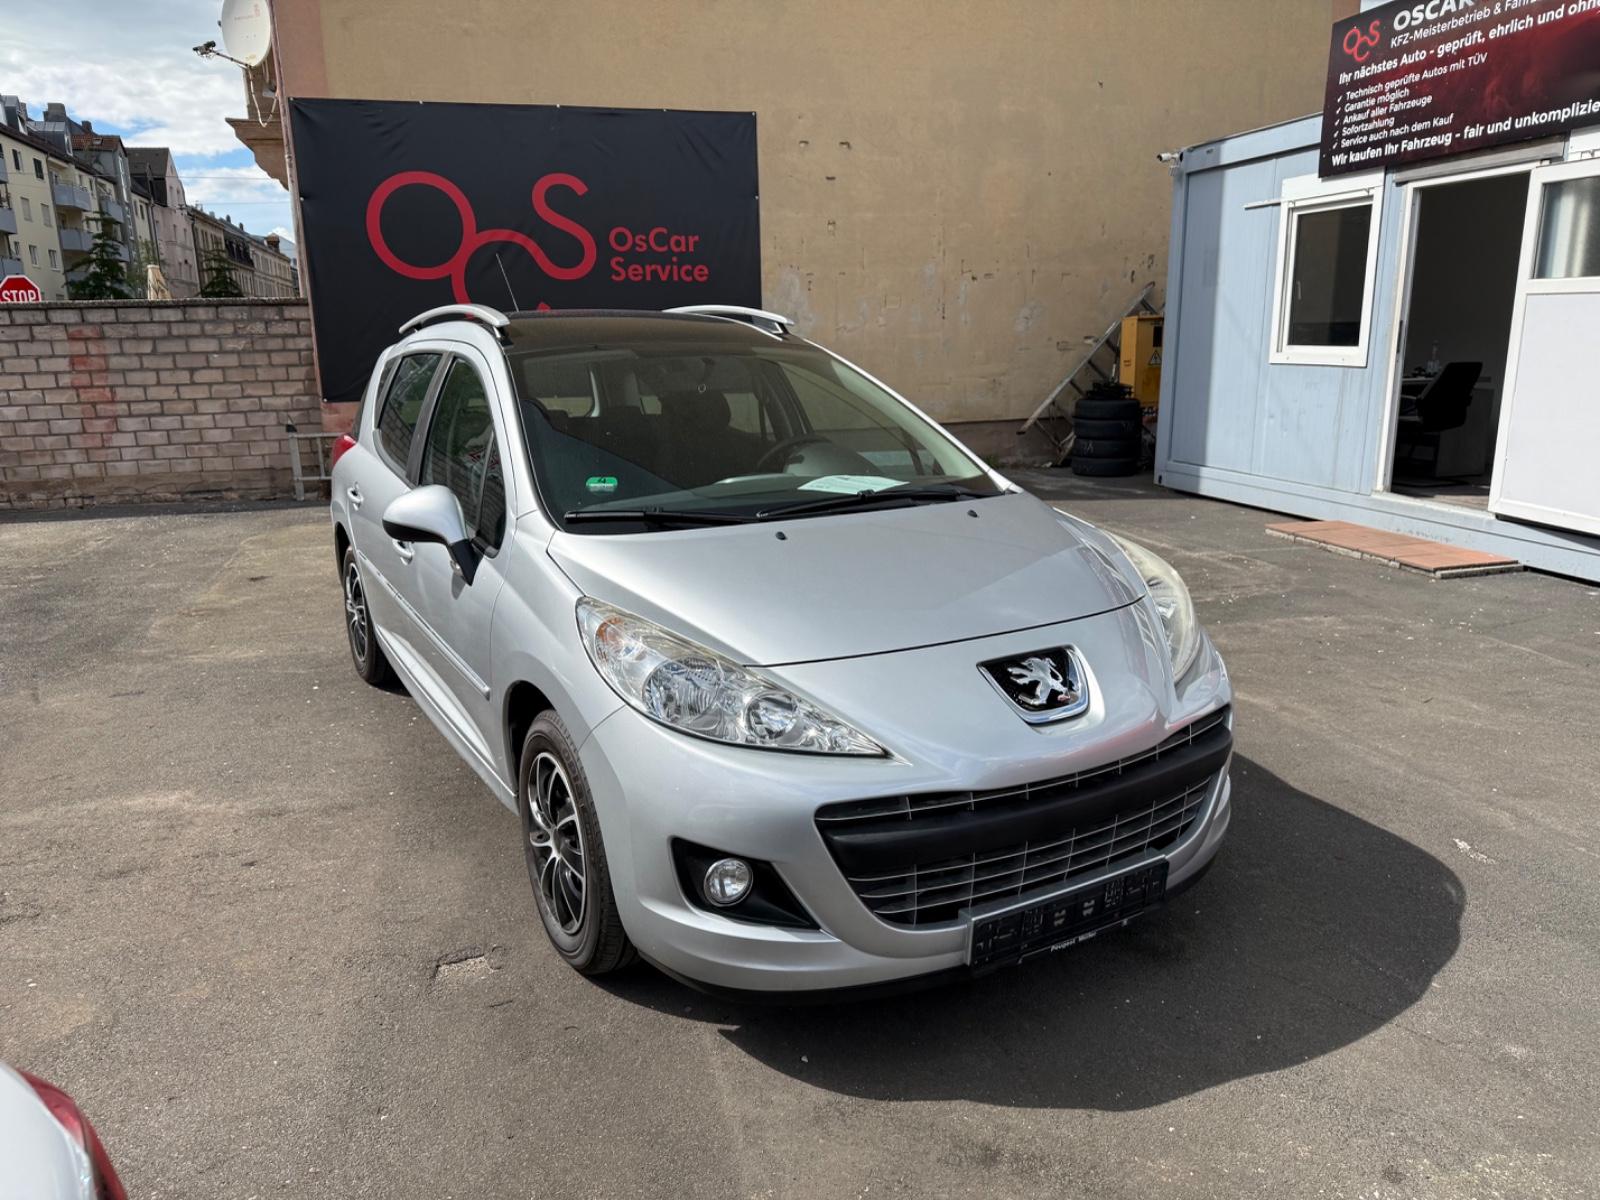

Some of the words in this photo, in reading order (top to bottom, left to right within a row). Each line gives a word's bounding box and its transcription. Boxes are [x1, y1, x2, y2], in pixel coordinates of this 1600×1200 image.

[1391, 7, 1491, 48] KFZ-Meisterbetrieb
[1493, 2, 1501, 15] &
[1338, 72, 1352, 85] Ihr
[1354, 58, 1398, 80] nächstes
[1400, 50, 1427, 67] Auto
[1437, 30, 1486, 54] geprüft,
[1489, 14, 1534, 39] ehrlich
[1537, 4, 1565, 25] und
[1345, 83, 1384, 101] Technisch
[1384, 72, 1421, 92] geprüfte
[1422, 64, 1448, 80] Autos
[1450, 59, 1465, 73] mit
[1468, 52, 1488, 67] TÜV
[1343, 109, 1370, 125] Ankauf
[1370, 107, 1387, 118] aller
[1389, 95, 1433, 113] Fahrzeuge
[1344, 98, 1376, 113] Garantie
[1377, 88, 1410, 104] möglich
[1341, 135, 1368, 148] Service
[1369, 130, 1388, 141] auch
[1389, 124, 1410, 137] nach
[1411, 119, 1431, 132] dem
[1432, 112, 1454, 128] Kauf
[1342, 116, 1395, 136] Sofortzahlung
[1332, 153, 1348, 167] Wir
[1349, 146, 1382, 163] kaufen
[1384, 142, 1399, 156] Ihr
[1401, 132, 1453, 152] Fahrzeug
[1464, 123, 1485, 139] fair
[1487, 117, 1513, 135] und
[609, 226, 700, 253] OsCar
[611, 256, 709, 283] Service
[2, 290, 37, 303] STOP
